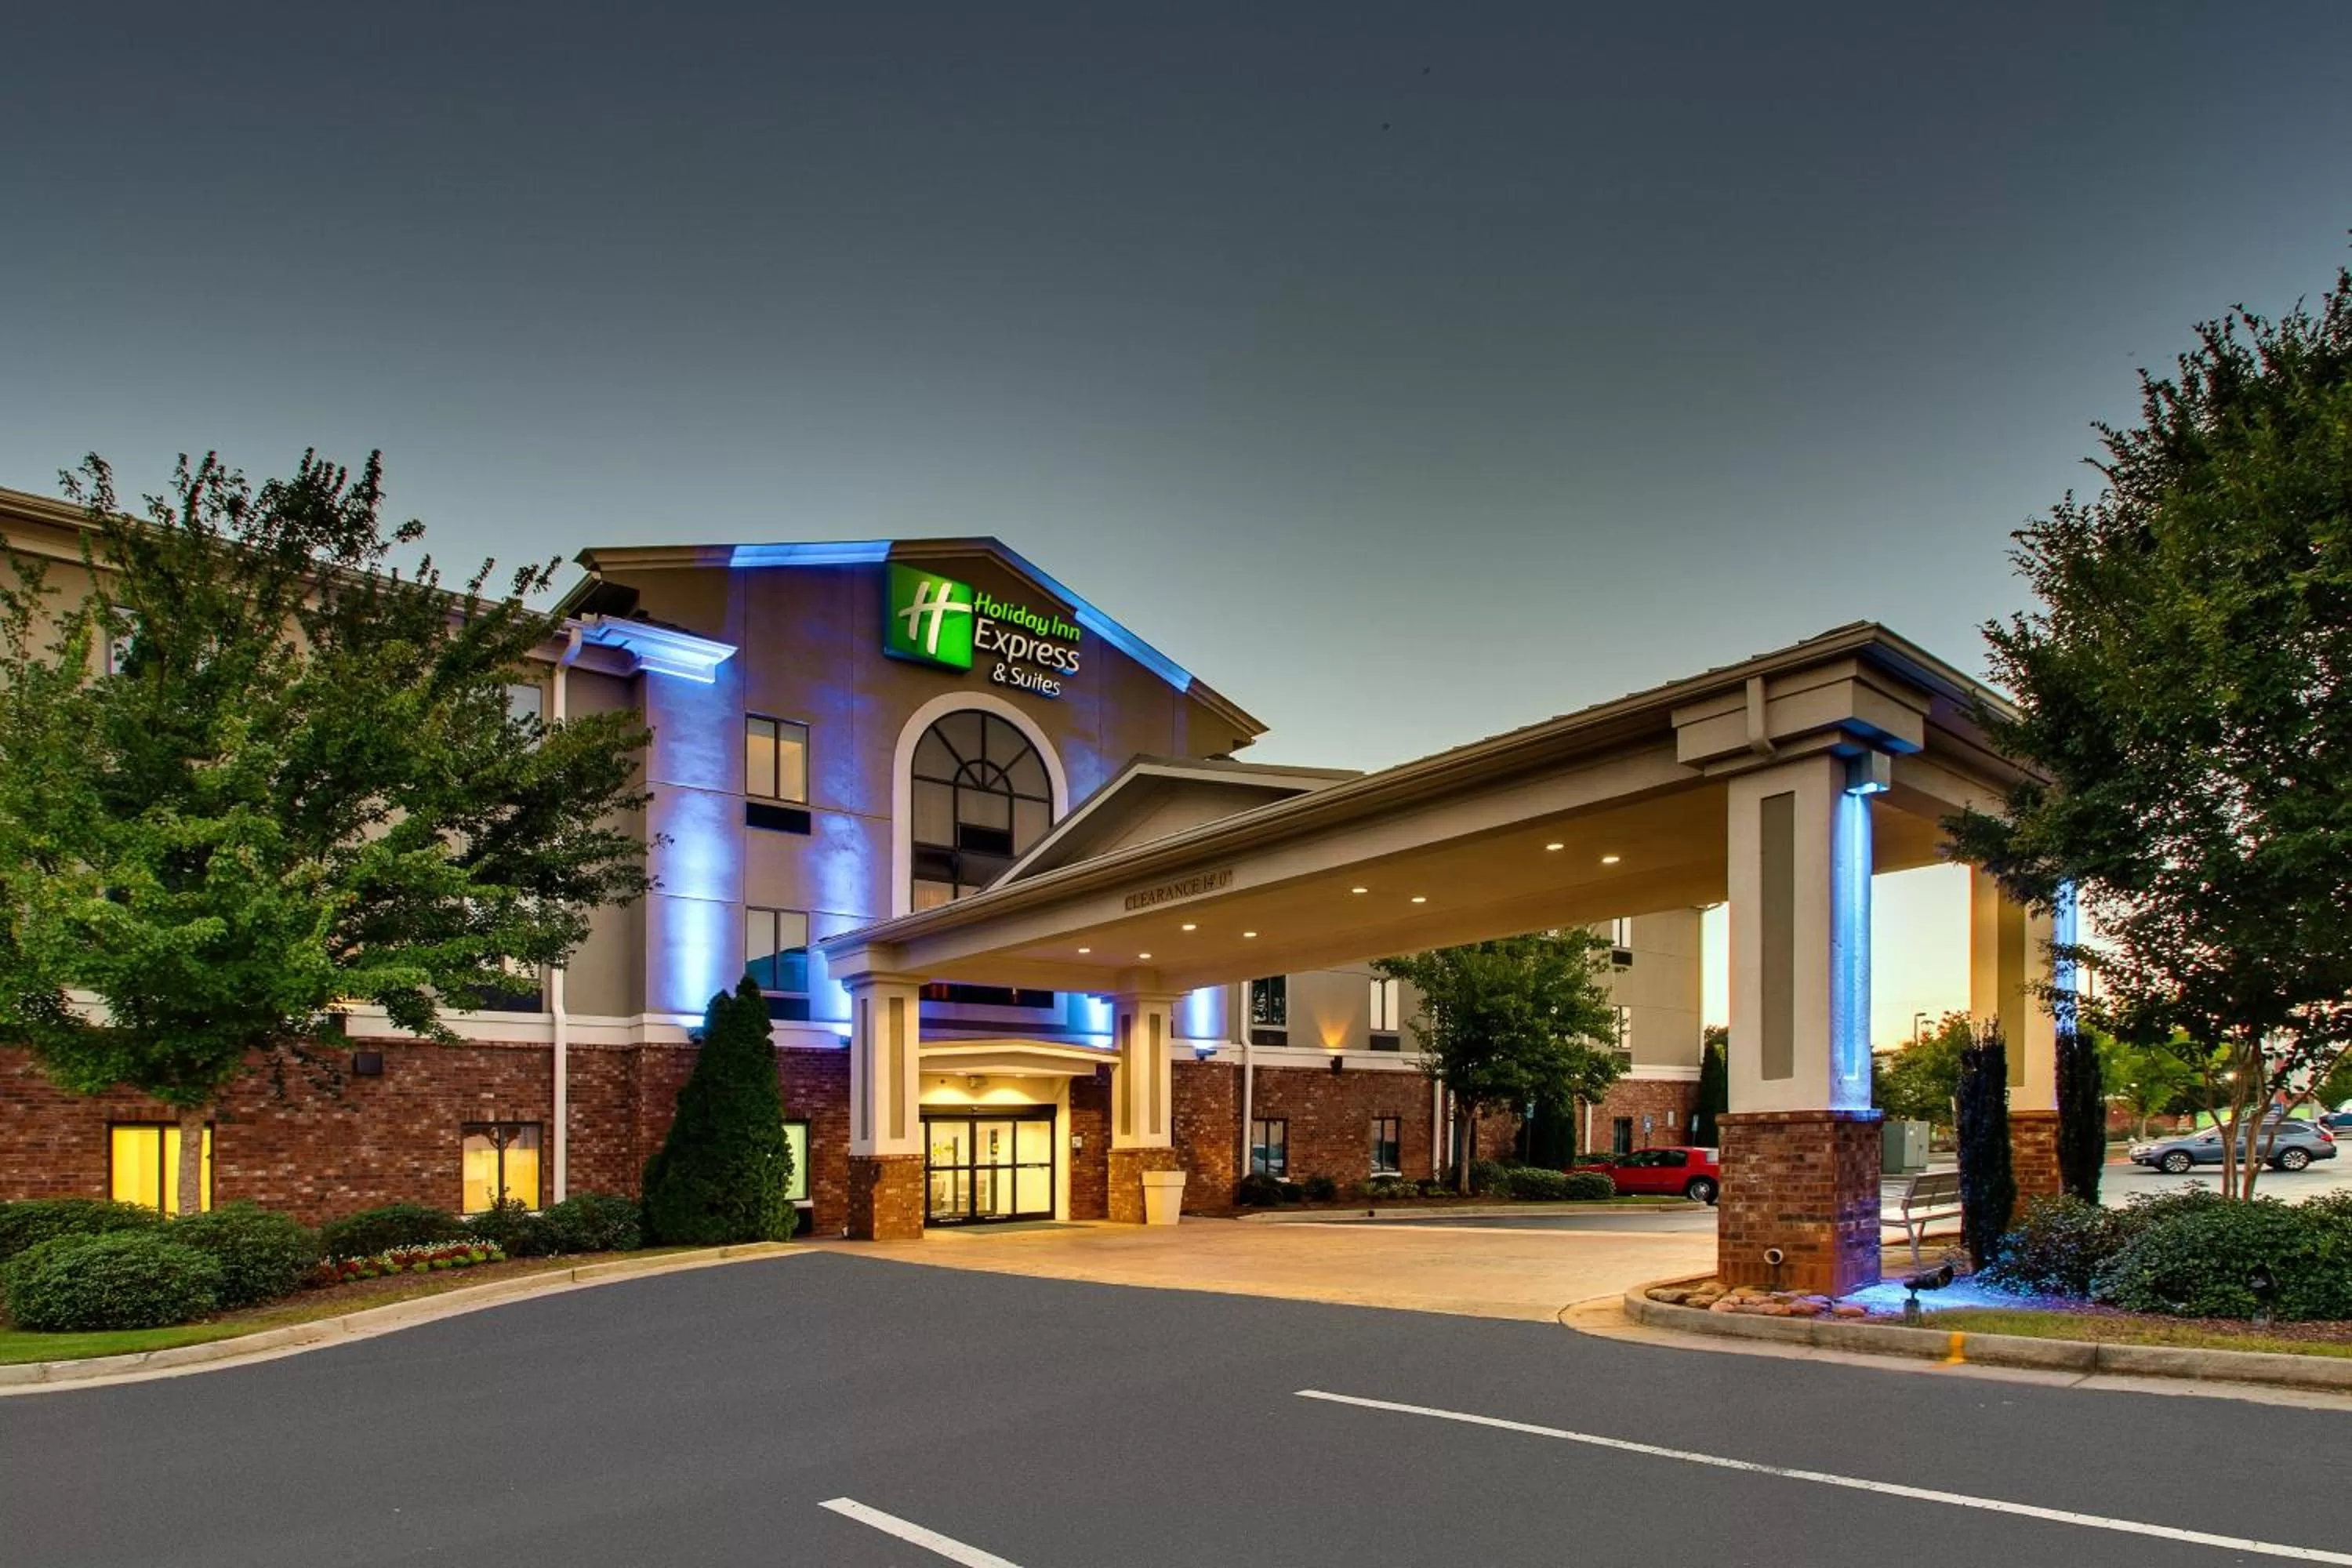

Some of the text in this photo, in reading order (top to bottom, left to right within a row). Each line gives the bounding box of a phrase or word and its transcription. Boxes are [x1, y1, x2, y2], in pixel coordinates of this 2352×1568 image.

[974, 592, 1081, 642] Holiday Inn
[975, 617, 1080, 673] Express
[993, 662, 1061, 696] & Suites
[1125, 877, 1200, 911] CLEARANCE
